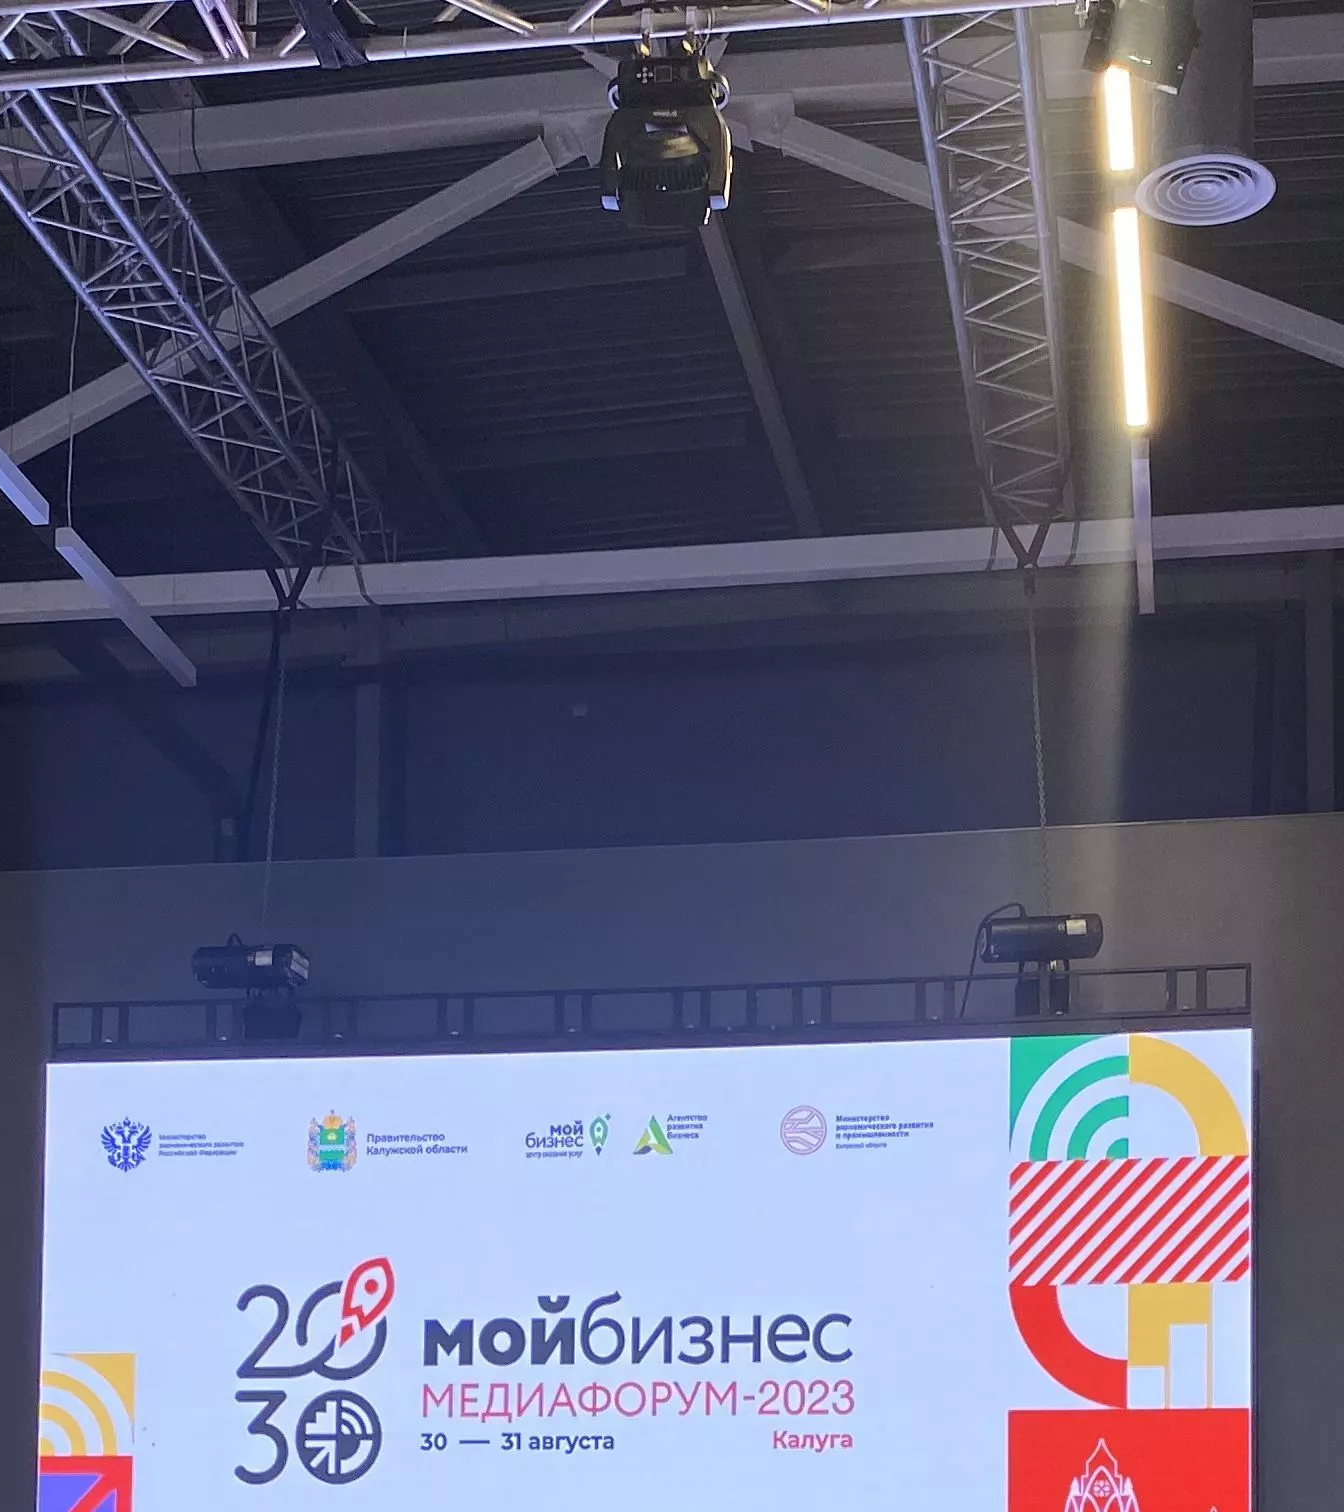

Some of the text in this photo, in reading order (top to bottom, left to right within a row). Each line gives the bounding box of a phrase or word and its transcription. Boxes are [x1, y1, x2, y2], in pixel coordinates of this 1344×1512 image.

[550, 1119, 584, 1136] мой
[366, 1132, 445, 1144] Правительство
[525, 1131, 584, 1149] бизнес
[366, 1143, 468, 1157] Калужской области
[421, 1378, 856, 1424] МЕДИАФОРУМ-2023
[419, 1432, 447, 1451] 30
[501, 1432, 522, 1451] 31
[528, 1432, 615, 1455] августа
[772, 1429, 854, 1454] Калуга
